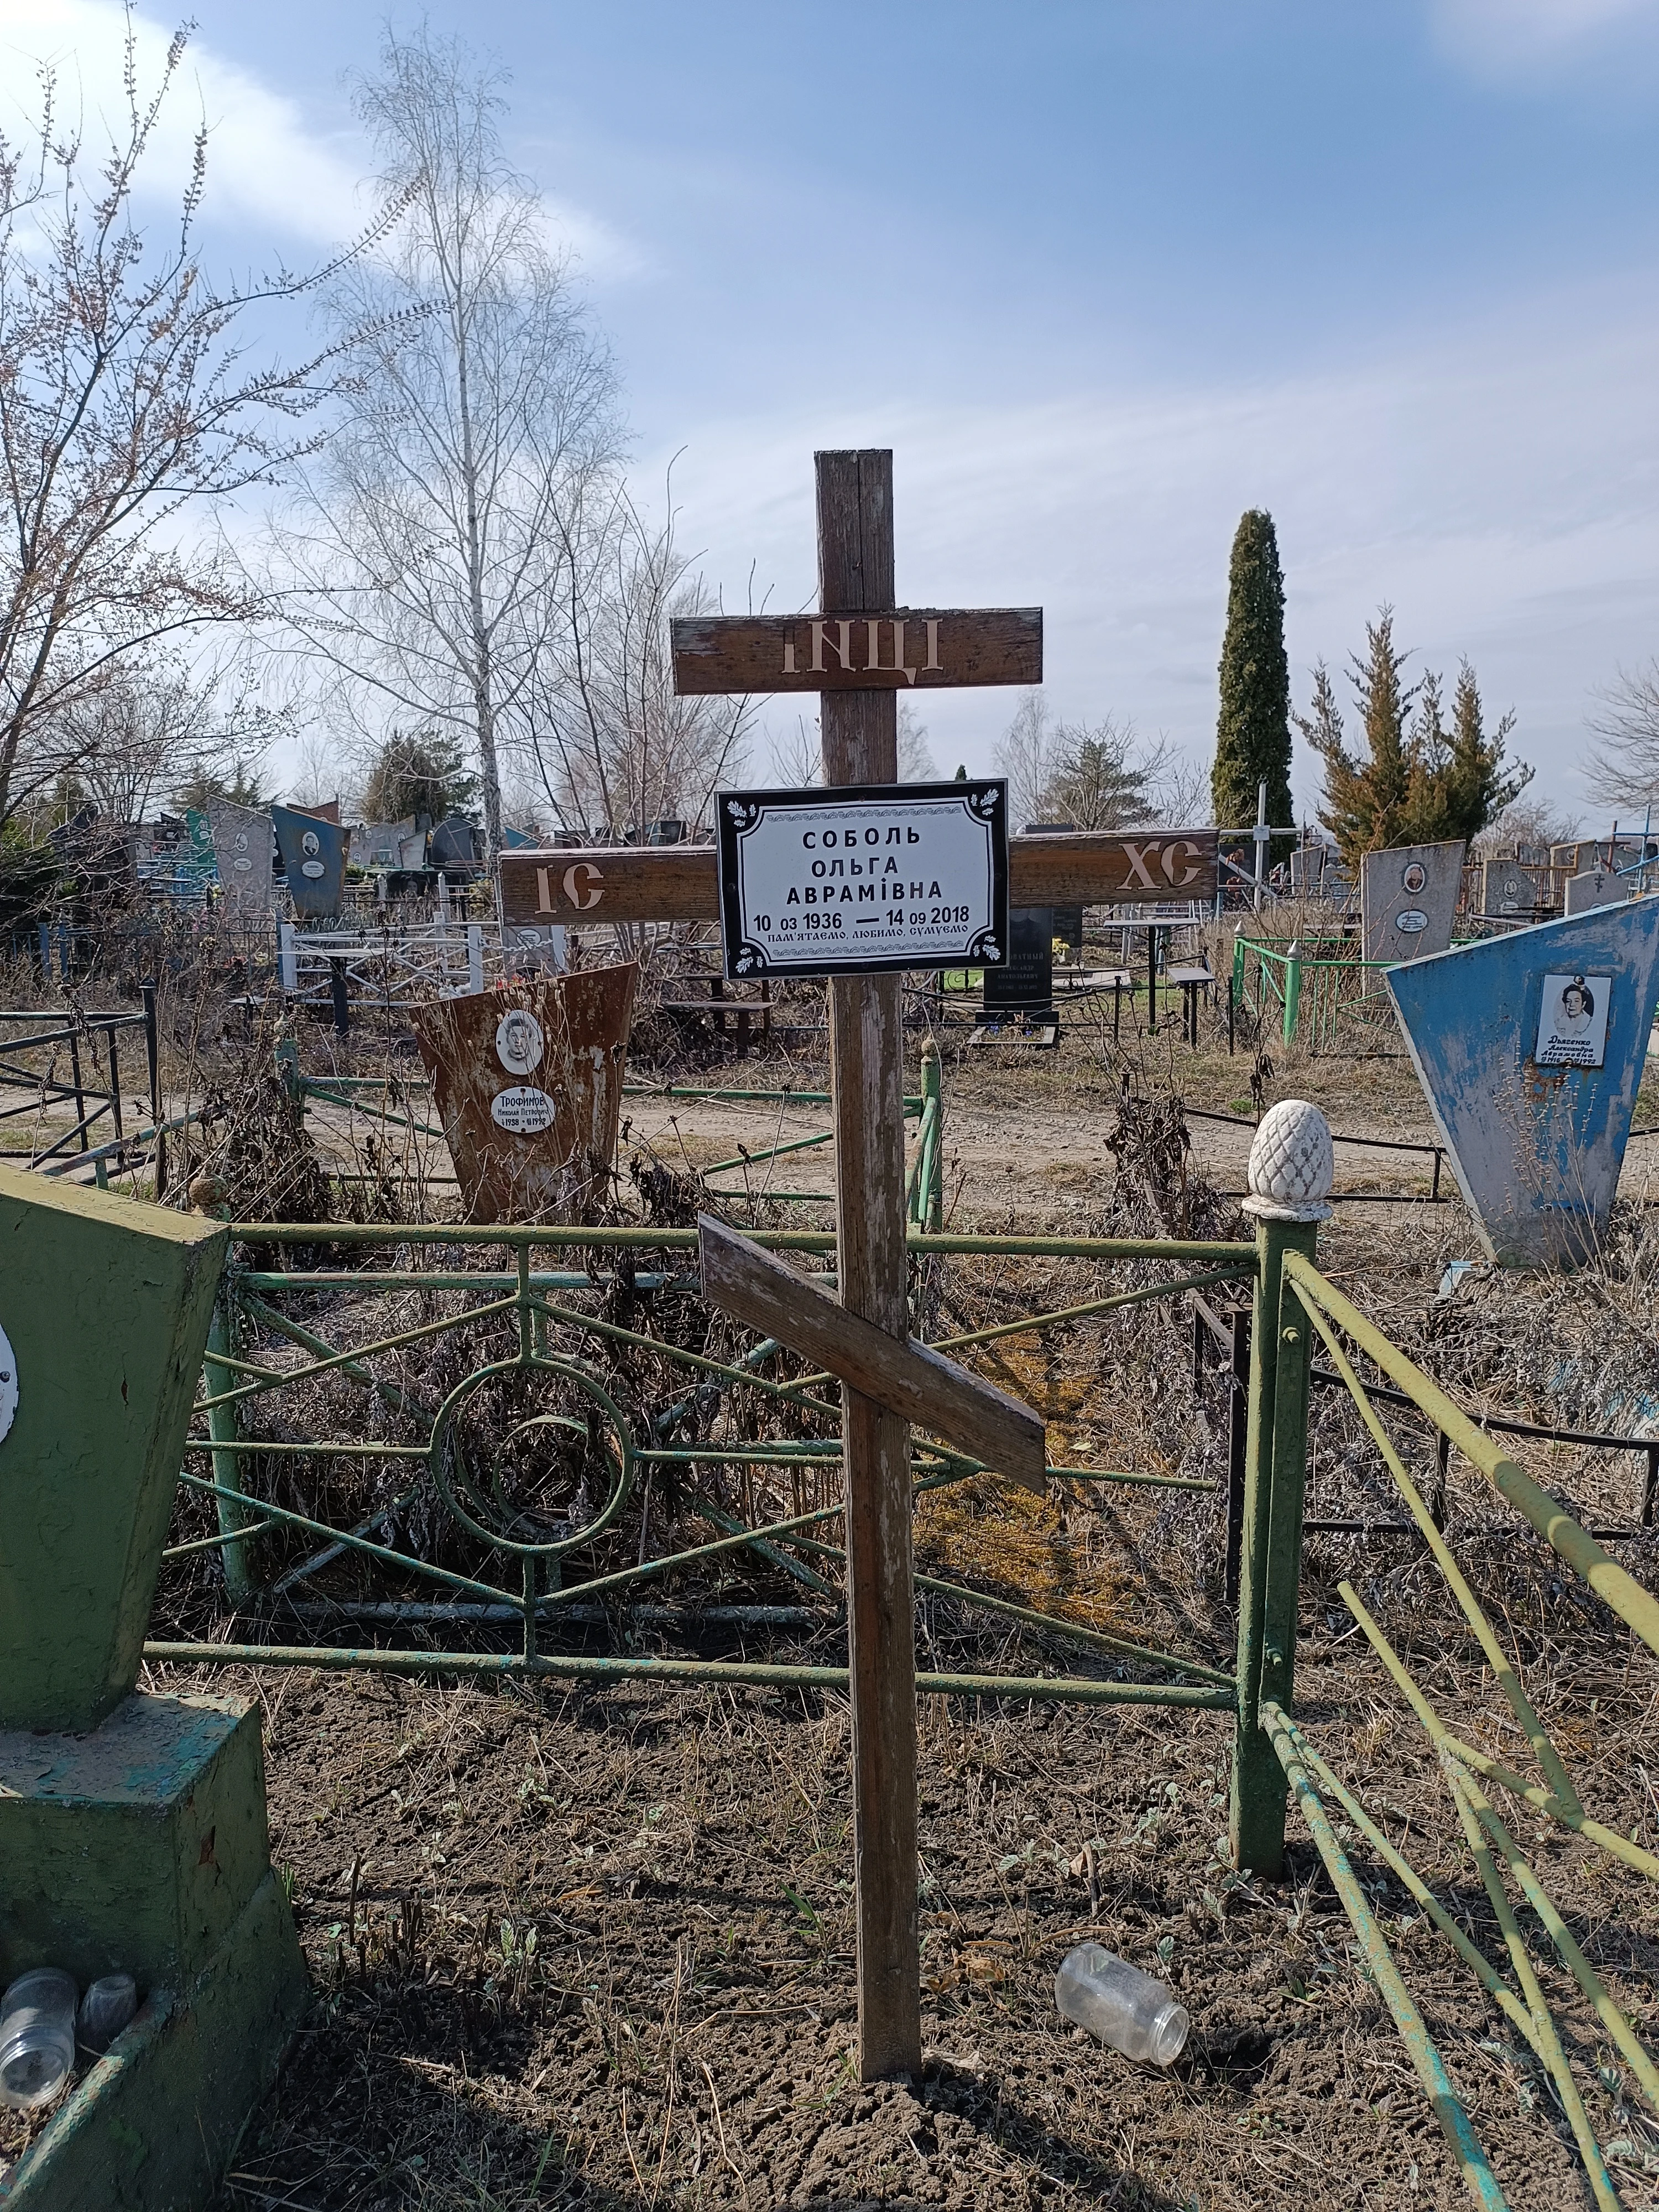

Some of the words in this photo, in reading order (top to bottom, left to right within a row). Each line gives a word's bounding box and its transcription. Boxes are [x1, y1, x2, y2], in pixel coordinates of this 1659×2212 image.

[802, 827, 920, 849] СОБОЛЬ
[811, 856, 898, 878] ОЛЬГА
[753, 915, 771, 931] 10
[780, 917, 797, 931] 03
[802, 912, 842, 930] 1936
[886, 909, 904, 926] 14
[909, 912, 926, 925] 09
[931, 905, 969, 924] 2018
